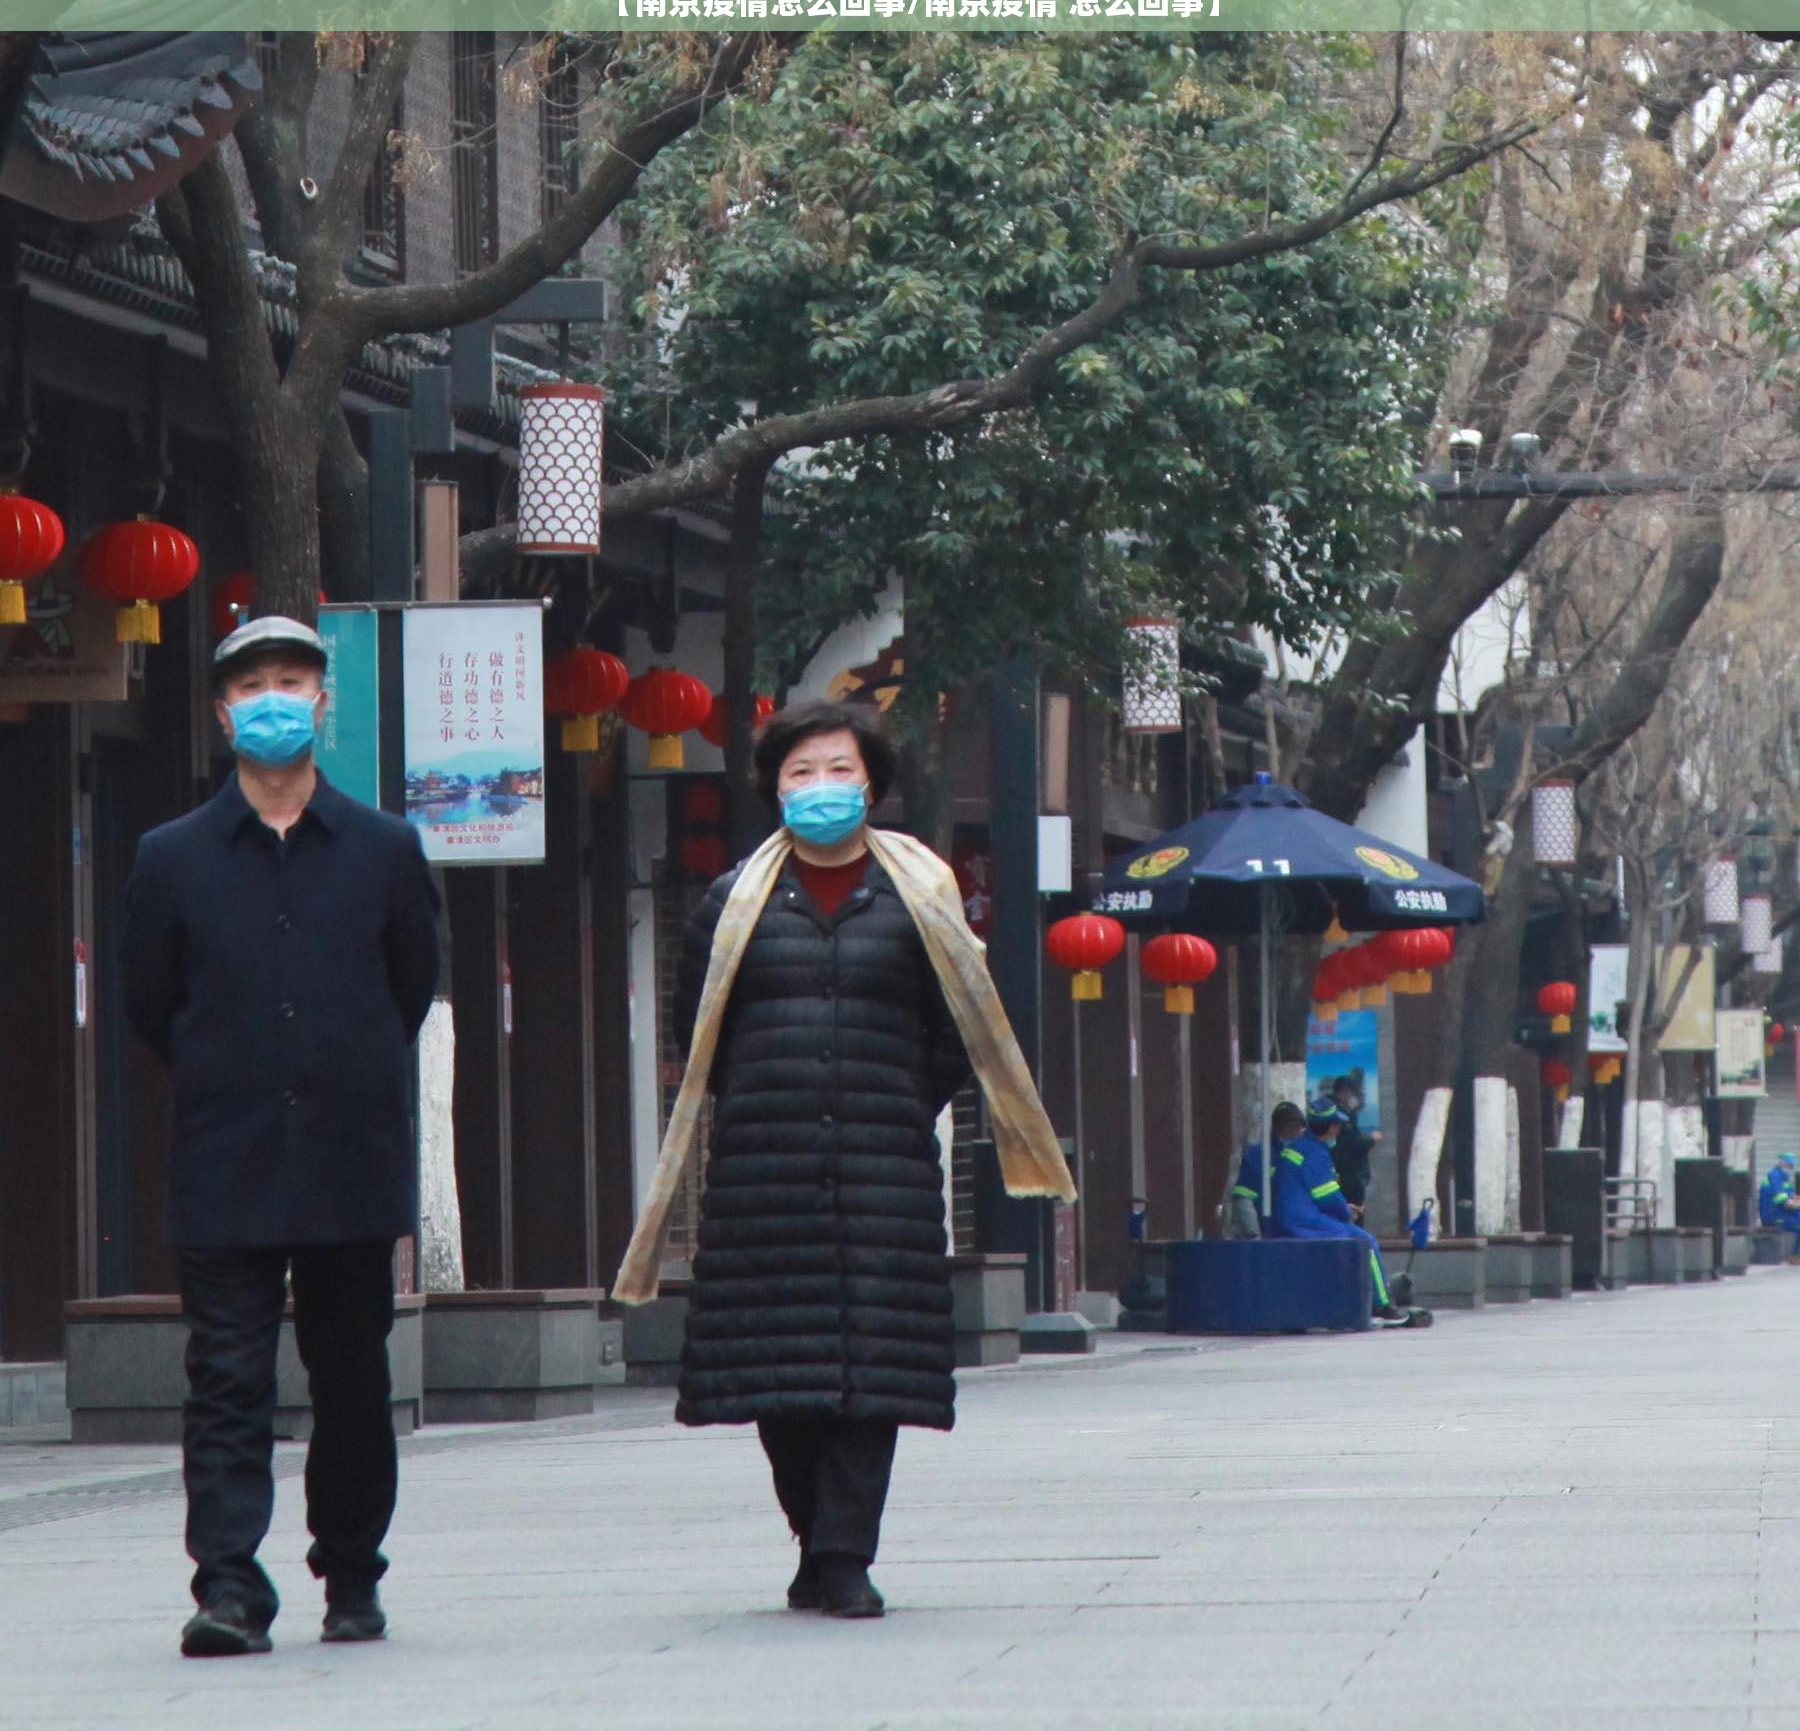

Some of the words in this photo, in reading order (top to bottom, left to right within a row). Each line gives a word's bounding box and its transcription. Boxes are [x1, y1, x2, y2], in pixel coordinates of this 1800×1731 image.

[438, 652, 455, 743] 行道德之事
[463, 652, 481, 742] 存功德之心
[488, 652, 505, 741] 做有德之人
[1393, 889, 1448, 912] 公安执勤
